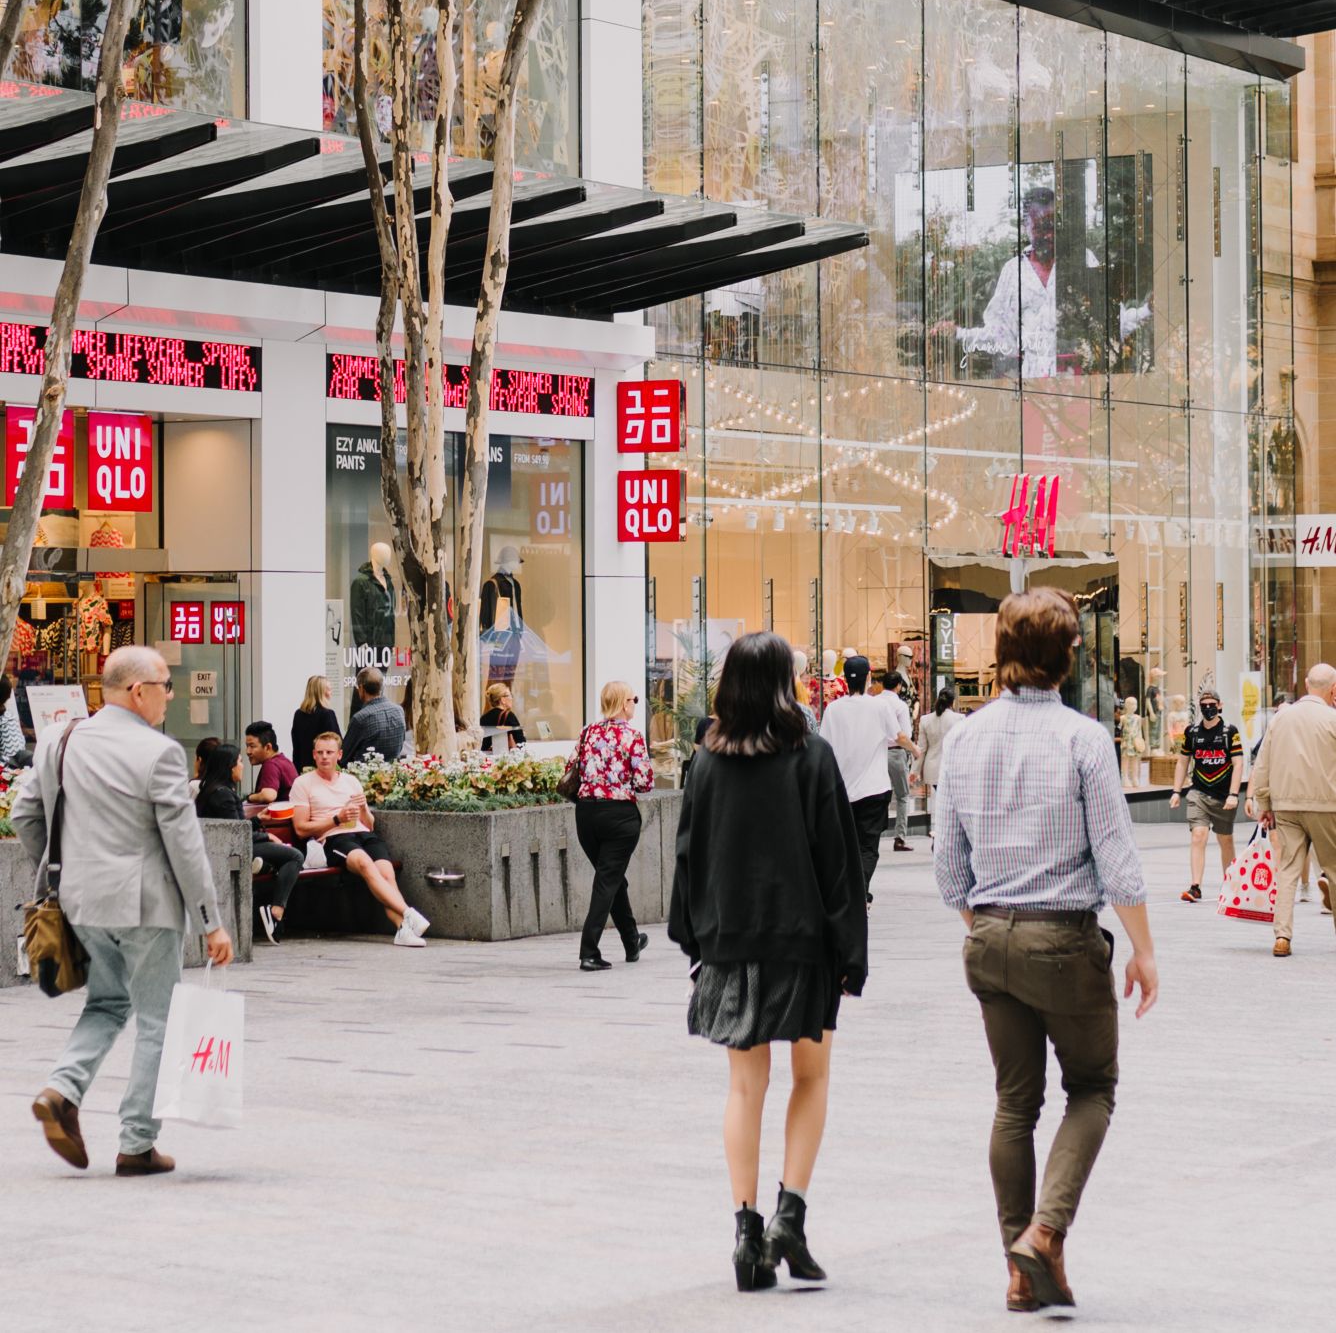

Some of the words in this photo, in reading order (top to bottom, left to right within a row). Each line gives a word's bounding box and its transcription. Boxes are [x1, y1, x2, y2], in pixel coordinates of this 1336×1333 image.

[96, 425, 141, 461] UNI
[336, 436, 354, 452] EZY
[356, 438, 381, 454] ANKL
[336, 454, 366, 471] PANTS
[96, 464, 146, 504] QLO
[624, 478, 668, 504] UNI
[624, 507, 673, 538] QLO
[195, 685, 214, 695] ONLY
[197, 673, 211, 682] EXIT
[190, 1035, 231, 1078] H&M
